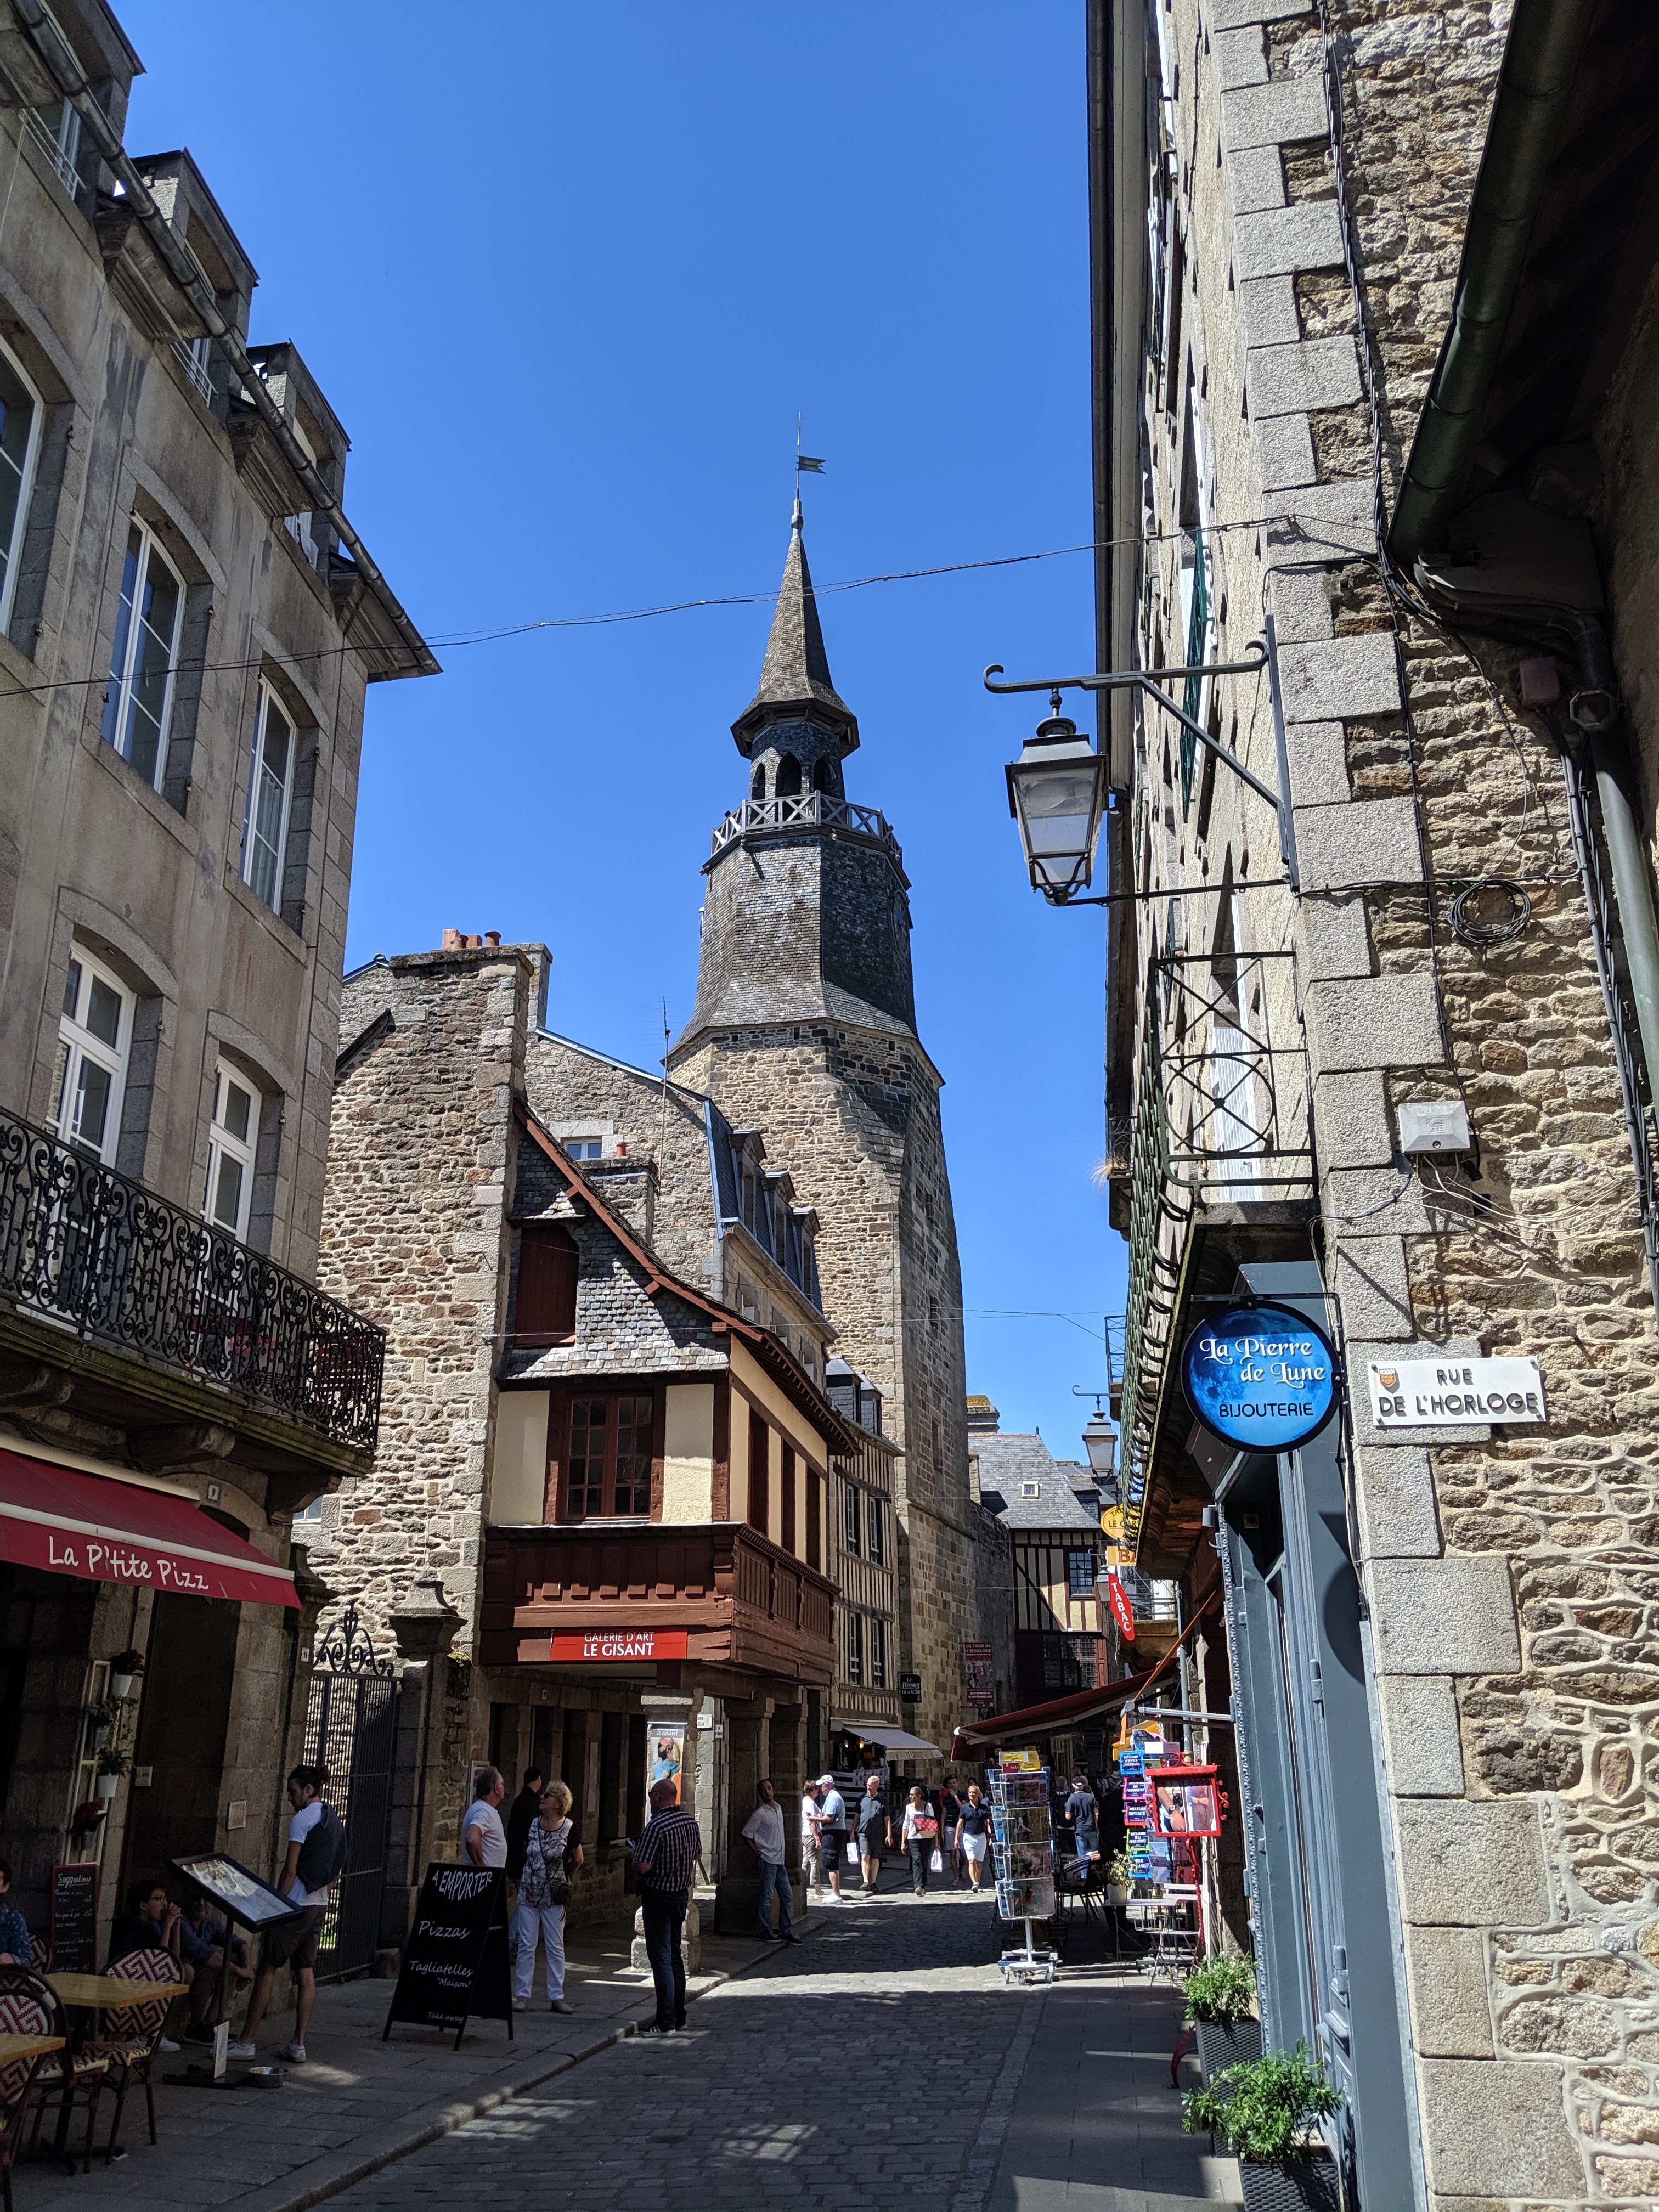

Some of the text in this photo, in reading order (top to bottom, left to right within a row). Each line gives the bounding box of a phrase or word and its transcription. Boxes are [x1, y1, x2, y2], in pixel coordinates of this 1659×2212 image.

[1200, 1336, 1312, 1365] La Pierre
[1240, 1362, 1325, 1389] de Lune
[1436, 1368, 1473, 1383] RUE
[1219, 1402, 1314, 1418] BIJOUTERIE
[1379, 1392, 1538, 1414] DE L'HORLOGE
[49, 1536, 209, 1590] La P'tite Pizz
[1111, 1582, 1131, 1632] TABAC
[584, 1632, 655, 1642] GALERIE D'ART
[584, 1643, 655, 1656] LE GISANT
[432, 1869, 493, 1901] A EMPORTER
[419, 1921, 471, 1940] Pizzas
[410, 1960, 474, 1978] Tagliatelles
[427, 2011, 464, 2024] Take away
